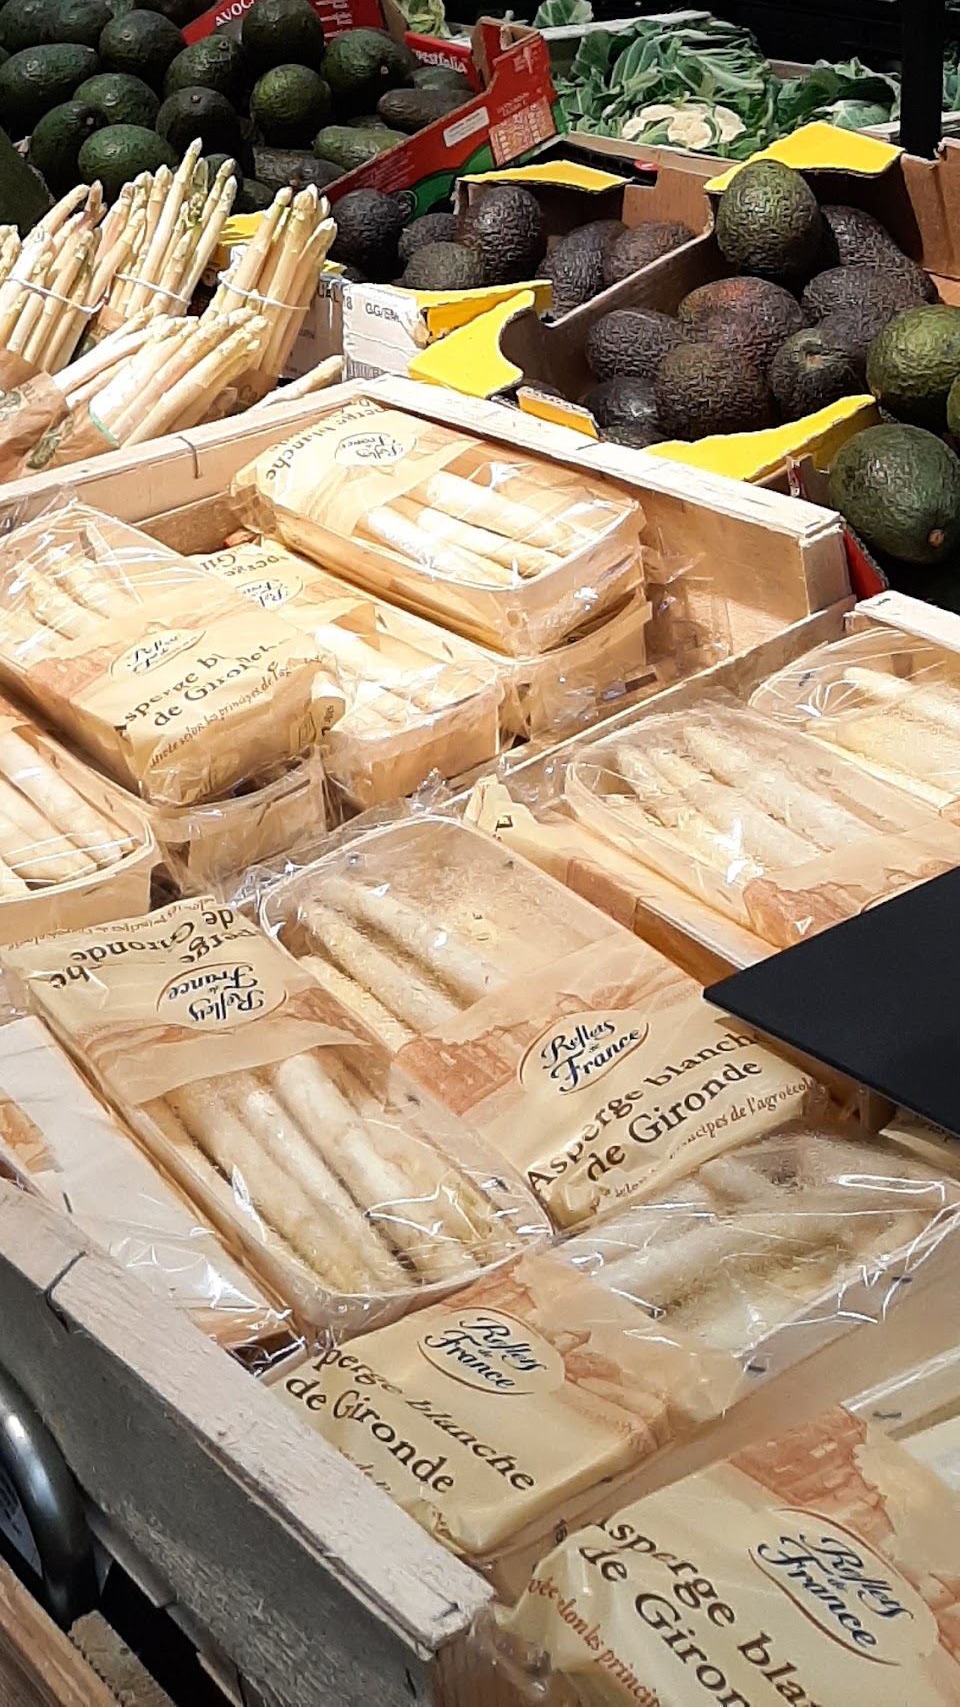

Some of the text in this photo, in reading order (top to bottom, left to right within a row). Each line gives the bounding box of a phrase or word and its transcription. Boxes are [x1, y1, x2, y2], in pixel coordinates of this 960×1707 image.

[154, 703, 183, 727] de
[202, 909, 234, 930] de
[168, 964, 258, 1000] France
[188, 988, 264, 1023] Reflets
[541, 1019, 616, 1069] Reflets
[550, 1029, 641, 1095] France
[526, 1032, 758, 1191] Asperge blanch
[586, 1061, 763, 1183] de Gironde
[731, 1104, 746, 1122] de
[424, 1330, 516, 1390] France
[459, 1317, 548, 1372] Reflets
[286, 1377, 455, 1494] de Gironde
[312, 1348, 535, 1491] perge blanche
[579, 1546, 628, 1583] de
[600, 1522, 736, 1629] sperge
[757, 1535, 877, 1648] France
[800, 1534, 914, 1620] Reflets
